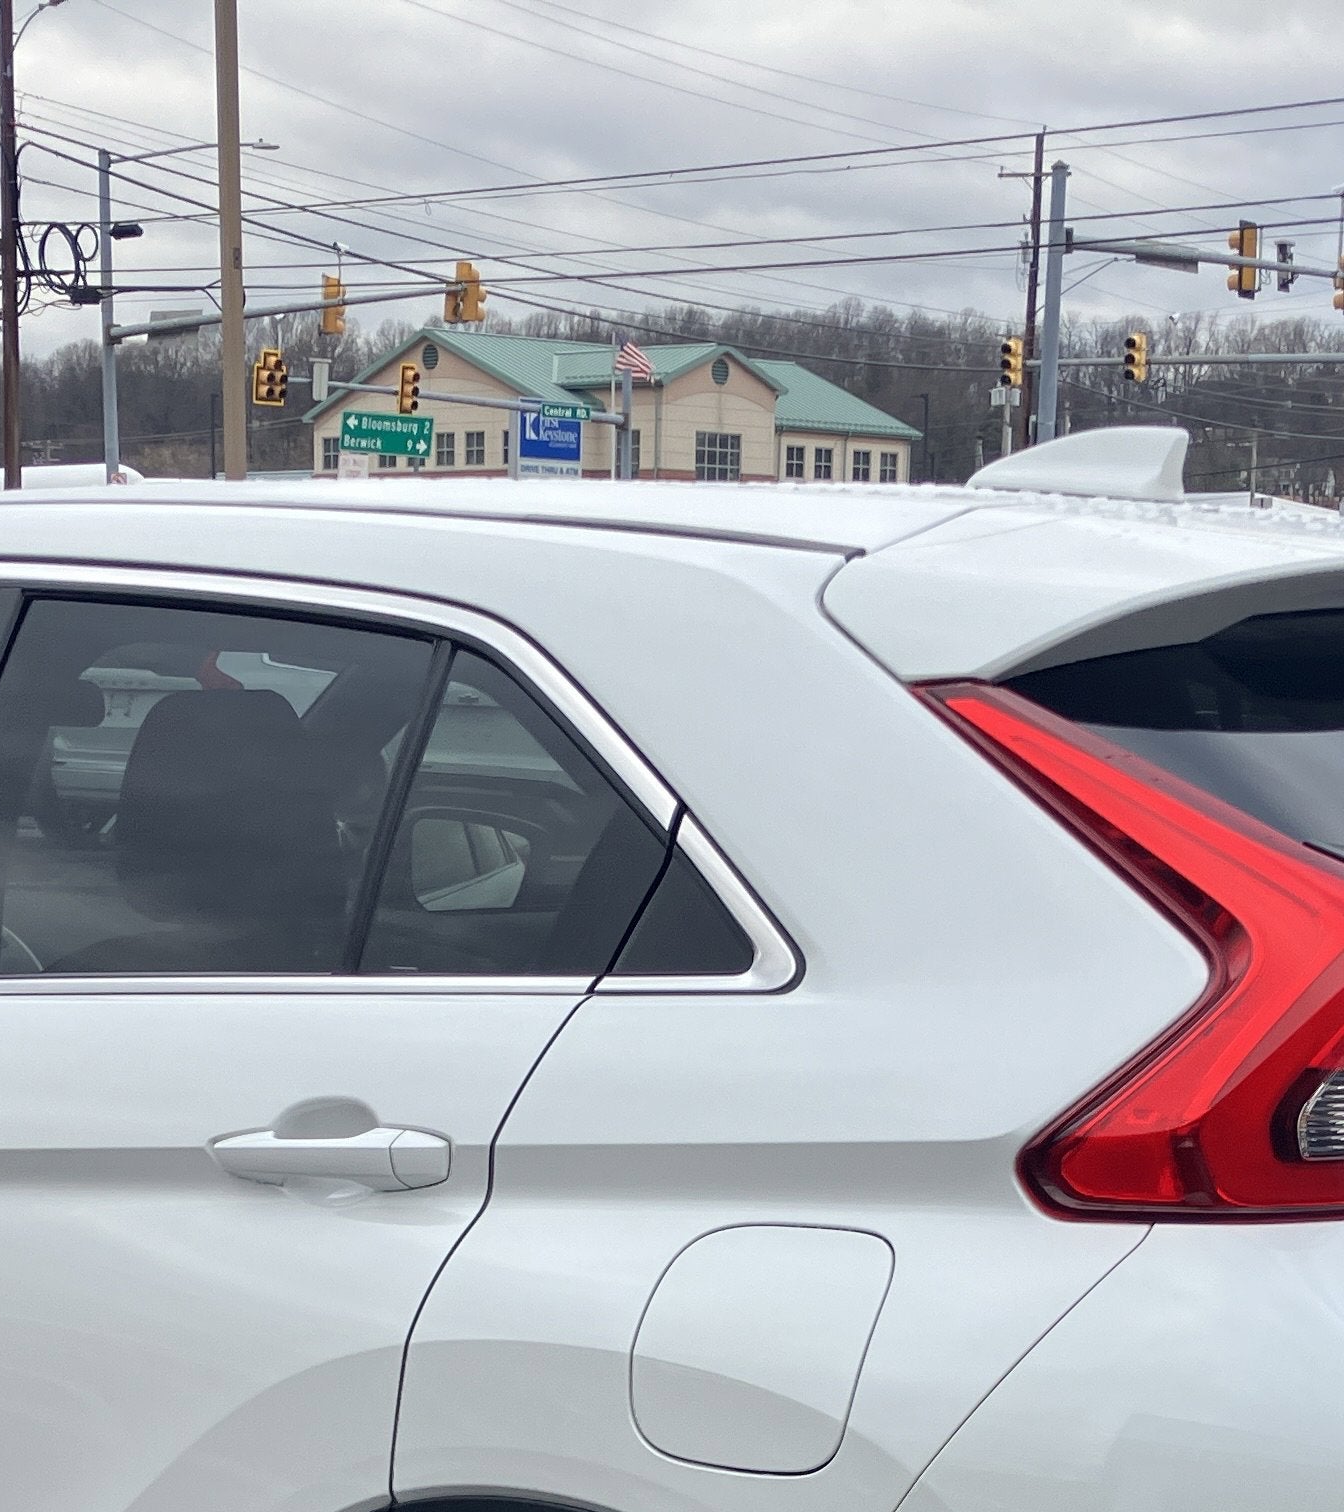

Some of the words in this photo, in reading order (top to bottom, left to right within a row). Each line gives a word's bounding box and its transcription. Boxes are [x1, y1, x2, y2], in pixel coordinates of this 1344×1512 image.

[544, 405, 572, 418] Central
[361, 416, 418, 435] Bloomsburg
[423, 421, 430, 434] 2
[343, 434, 382, 449] Berwick
[406, 439, 413, 451] 9
[540, 427, 578, 443] Keystone
